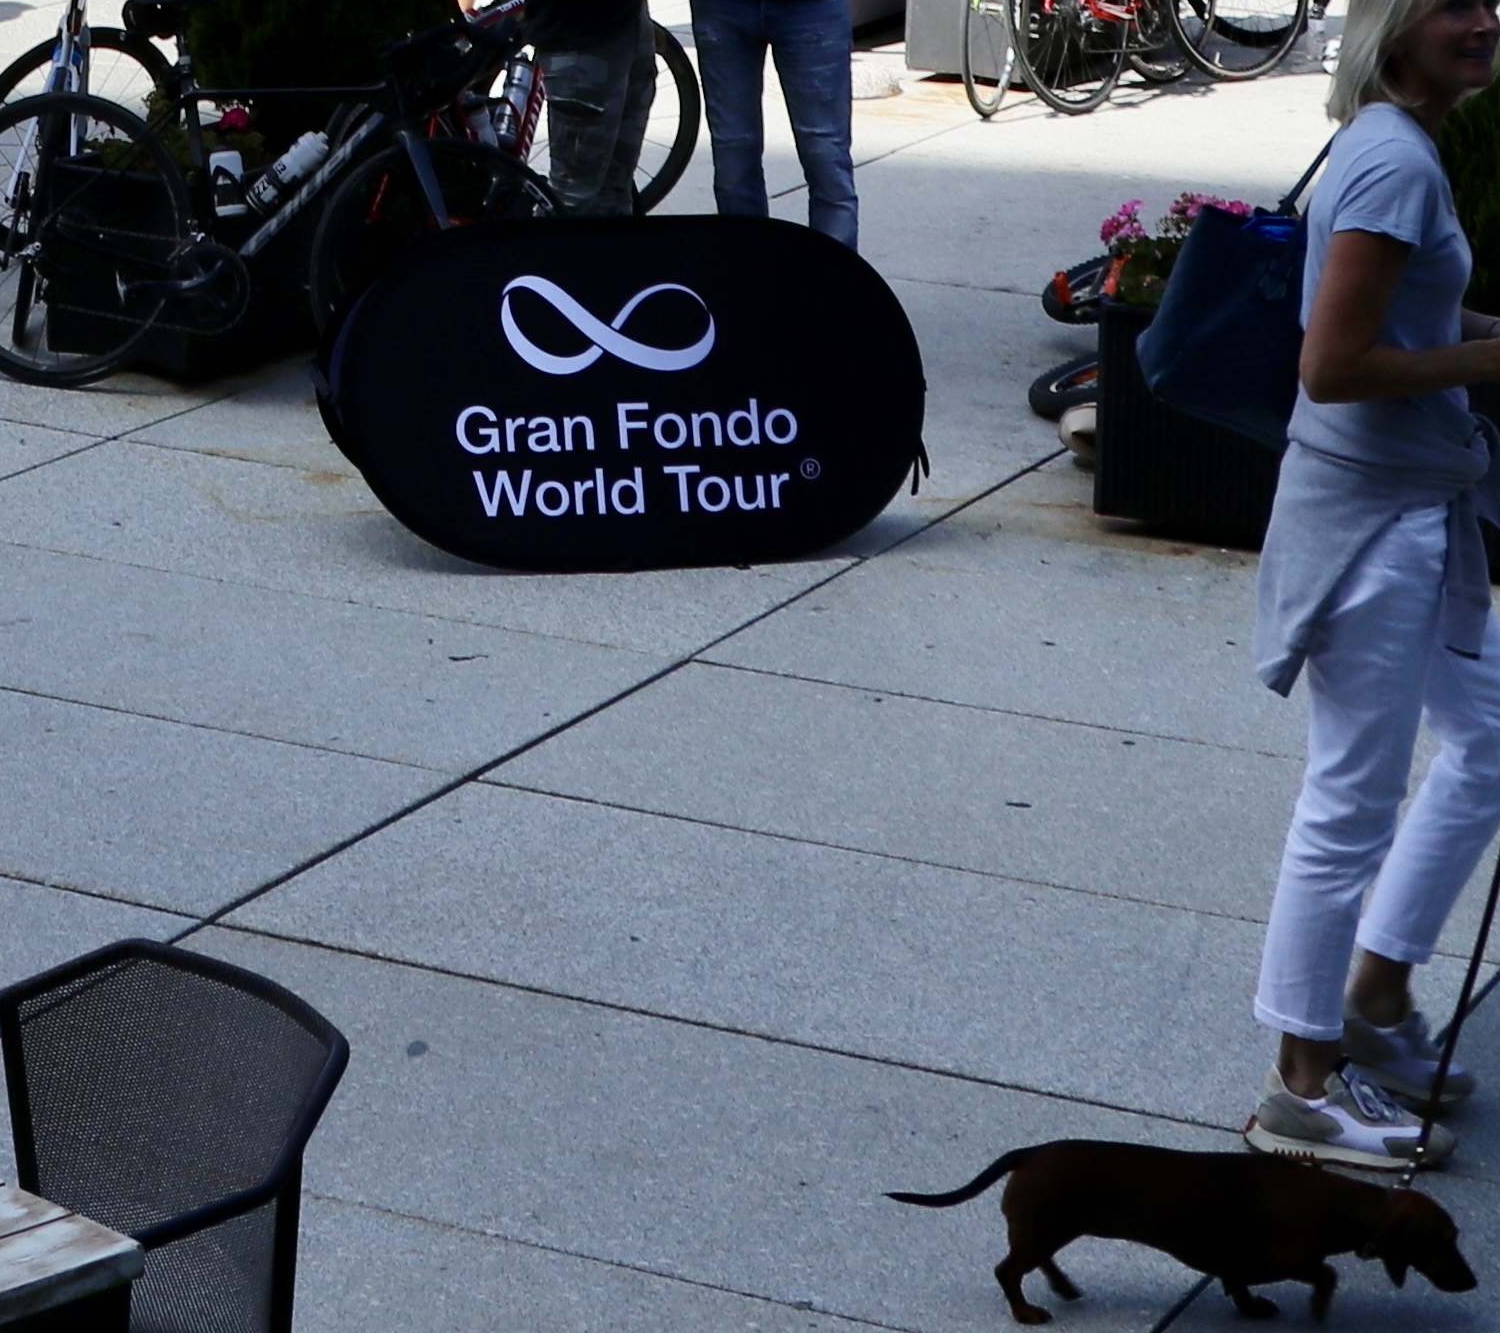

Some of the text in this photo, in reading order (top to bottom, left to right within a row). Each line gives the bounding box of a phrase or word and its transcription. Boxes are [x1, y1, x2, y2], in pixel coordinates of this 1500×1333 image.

[456, 398, 798, 455] Gran Fondo
[473, 464, 790, 517] World Tour
